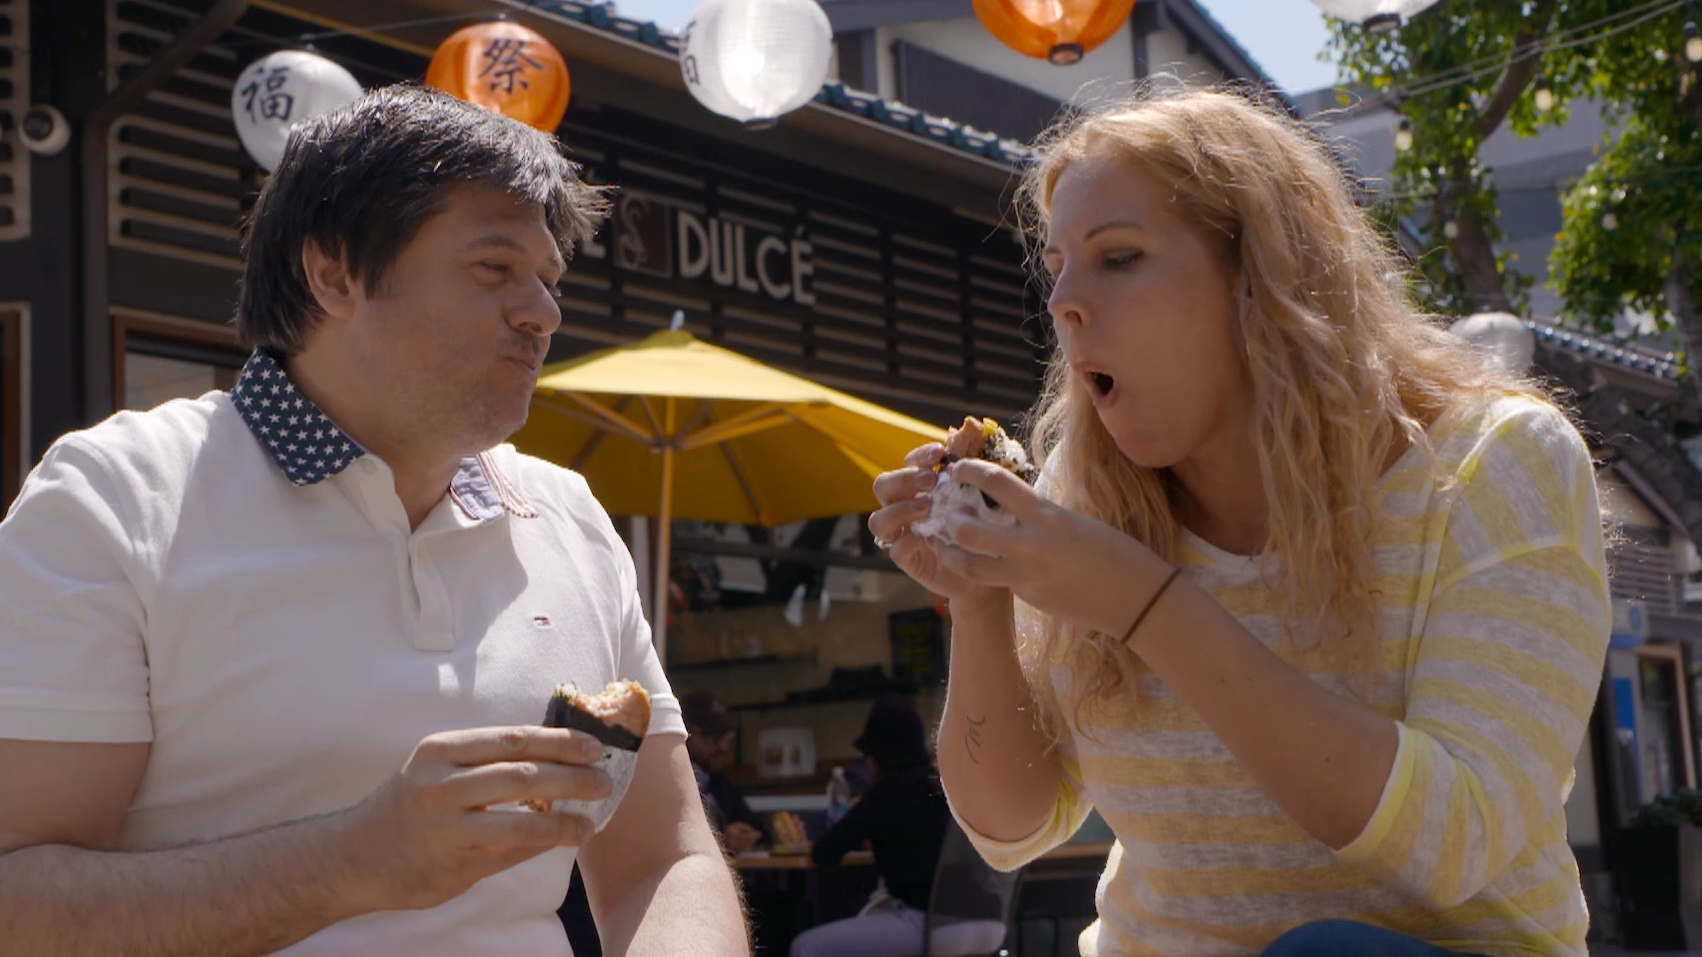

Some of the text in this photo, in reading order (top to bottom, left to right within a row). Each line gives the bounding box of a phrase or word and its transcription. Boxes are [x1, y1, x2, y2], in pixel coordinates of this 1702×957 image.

[241, 66, 294, 124] 福
[478, 38, 545, 95] 祭
[677, 209, 816, 305] DULCÉ
